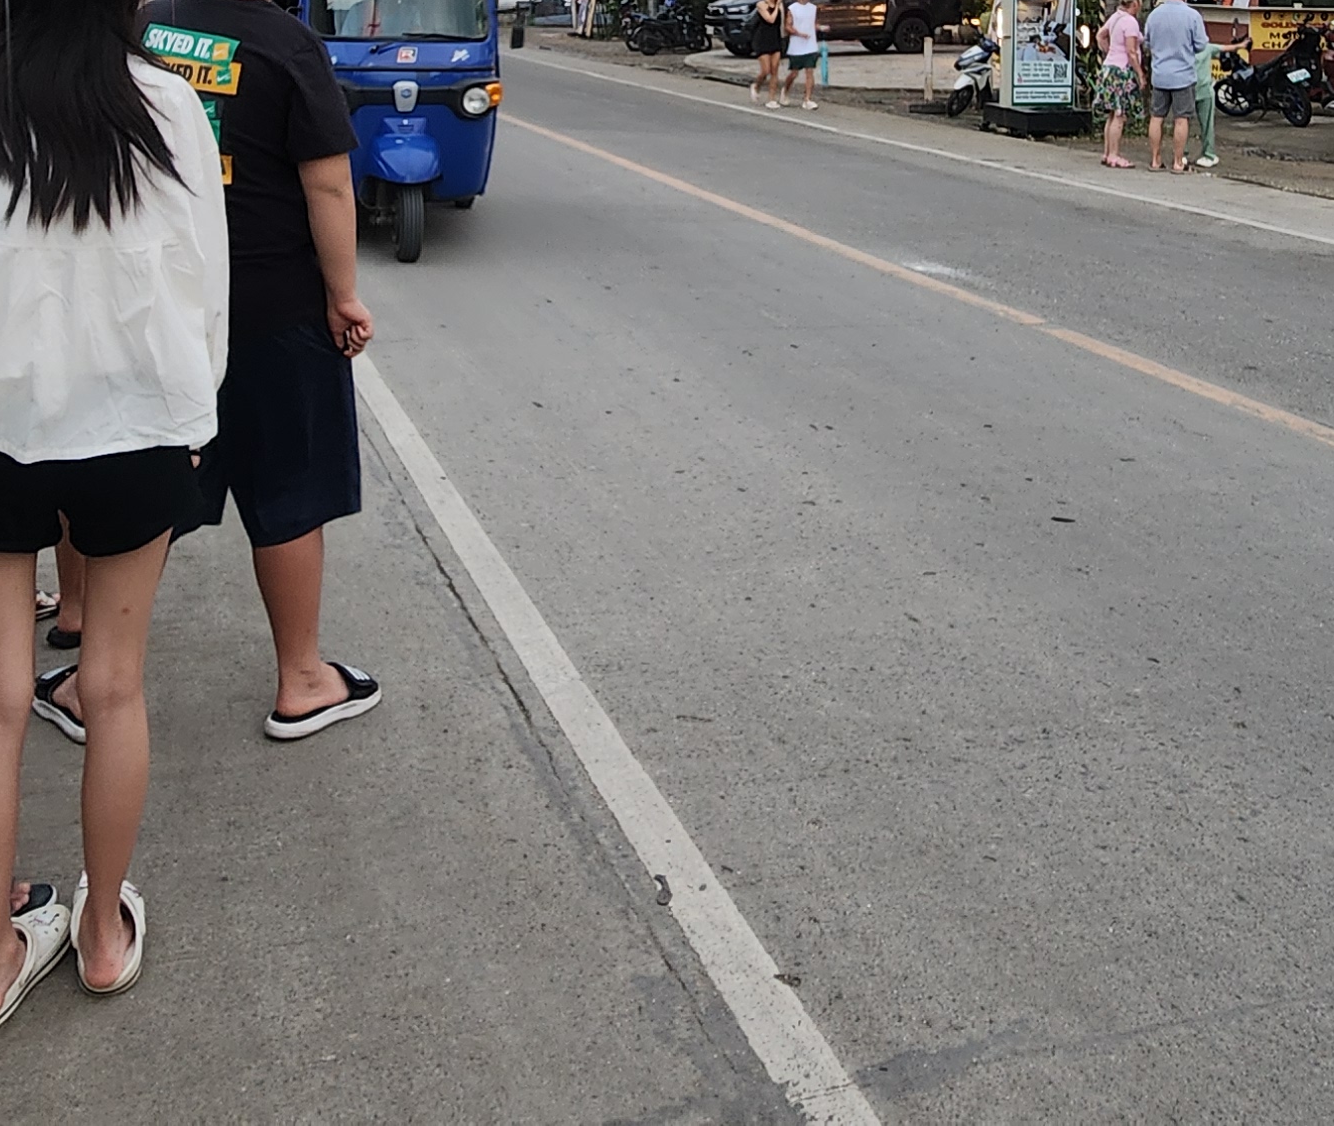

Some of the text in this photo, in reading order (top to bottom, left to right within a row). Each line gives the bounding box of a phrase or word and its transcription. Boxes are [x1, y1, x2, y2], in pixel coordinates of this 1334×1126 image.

[145, 28, 213, 59] SKYED IT.
[196, 66, 212, 85] IT.
